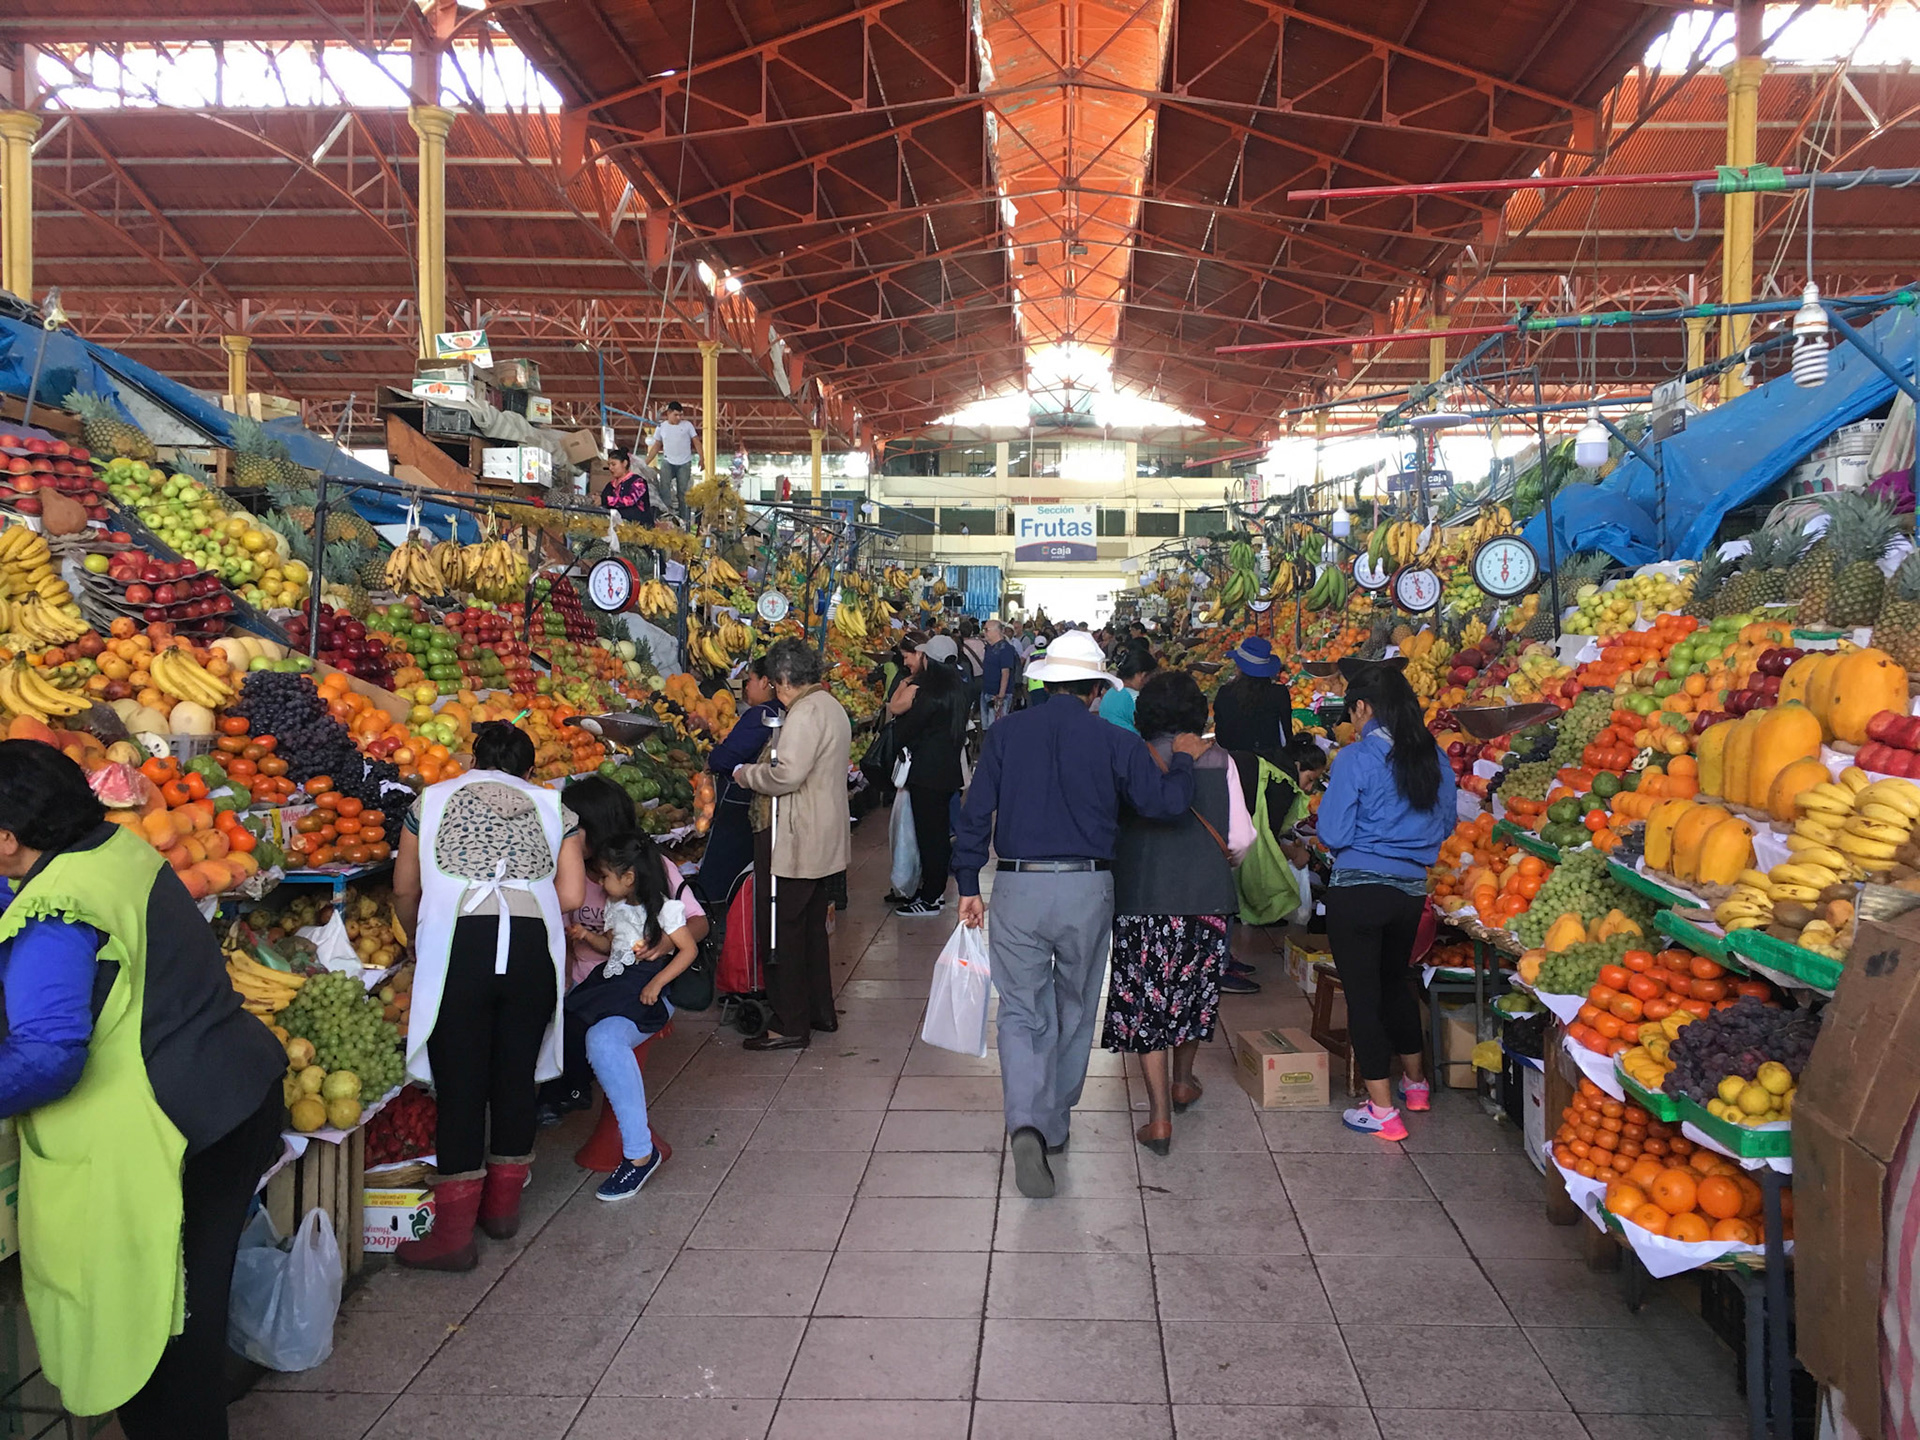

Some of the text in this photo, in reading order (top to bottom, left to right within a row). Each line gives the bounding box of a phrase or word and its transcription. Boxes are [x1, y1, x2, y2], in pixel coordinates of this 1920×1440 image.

[1661, 383, 1677, 411] 24
[1037, 506, 1074, 514] Sección
[1021, 518, 1093, 537] Frutas
[1051, 546, 1072, 556] caja
